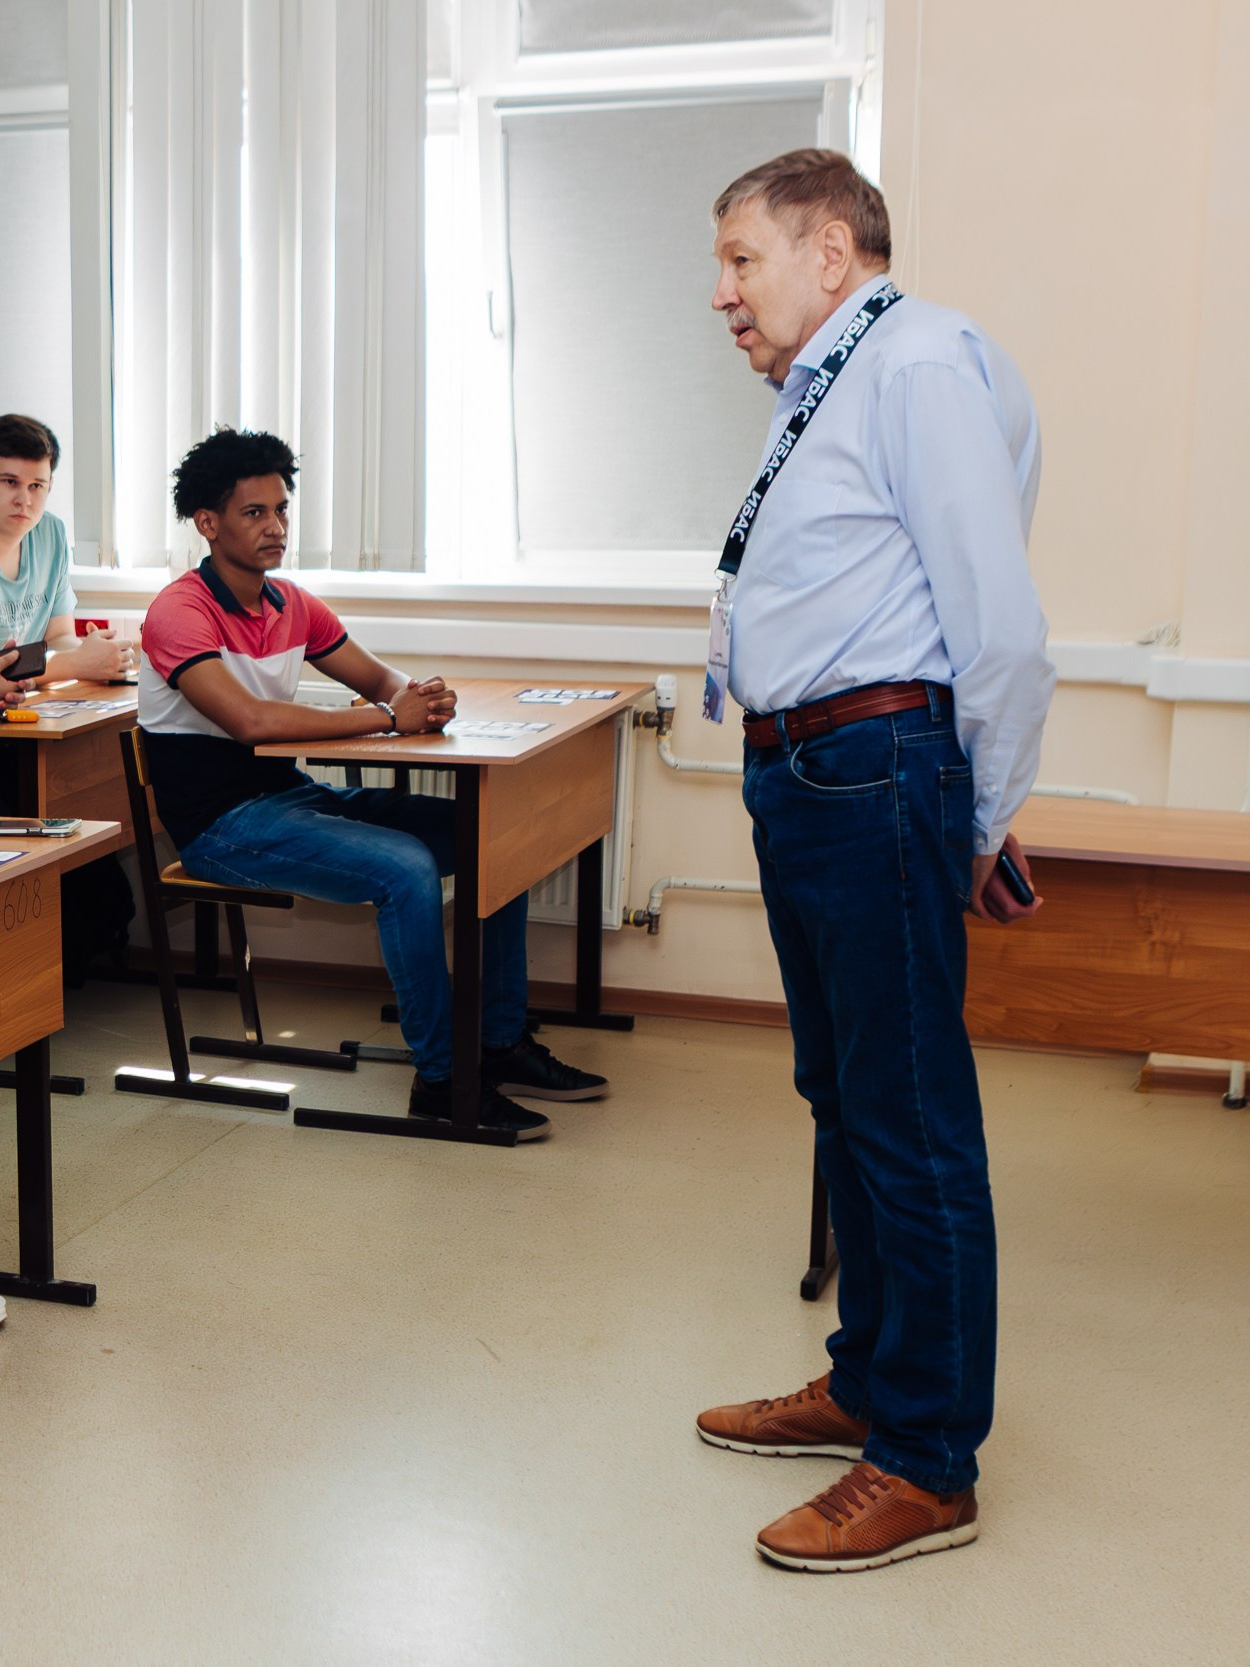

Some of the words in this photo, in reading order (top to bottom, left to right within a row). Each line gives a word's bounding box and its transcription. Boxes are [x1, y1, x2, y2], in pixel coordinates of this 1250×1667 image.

[830, 309, 874, 361] ИБАС
[794, 368, 834, 422] ИБАС
[762, 429, 797, 482] ИБАС
[730, 490, 762, 543] ИБАС
[4, 879, 42, 931] 608
